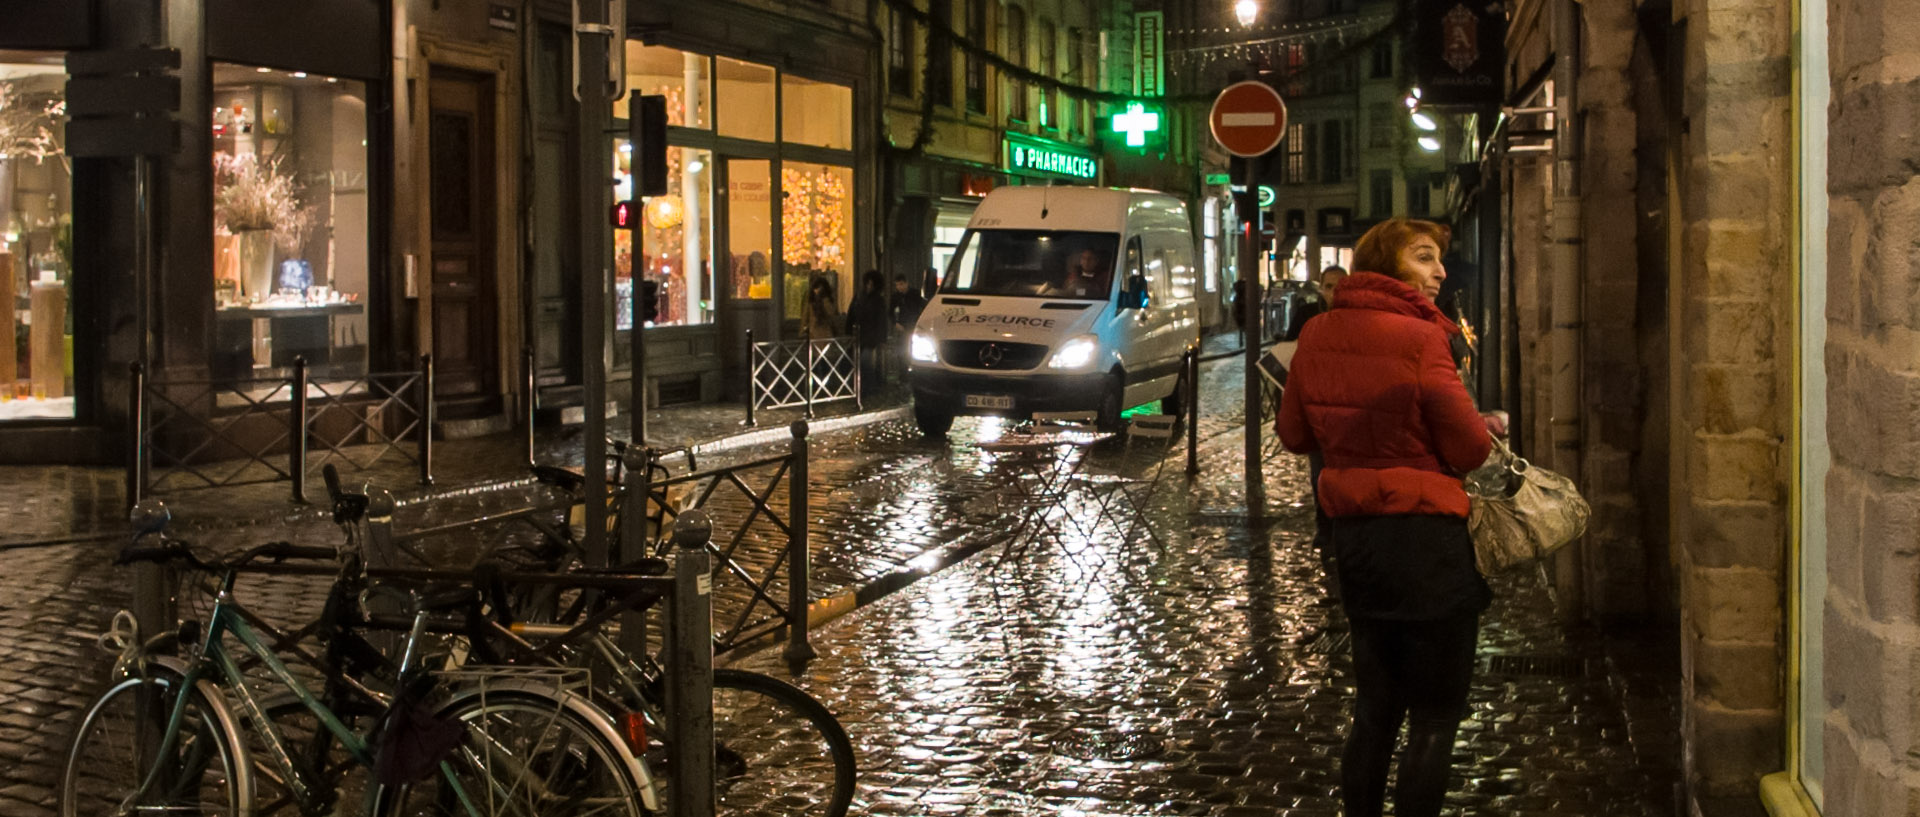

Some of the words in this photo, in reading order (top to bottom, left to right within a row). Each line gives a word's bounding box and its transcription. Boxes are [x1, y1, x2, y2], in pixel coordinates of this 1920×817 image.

[1449, 26, 1471, 49] A
[1027, 148, 1089, 178] PHARMACIE
[947, 315, 970, 323] LA
[974, 315, 1056, 328] SOURCE
